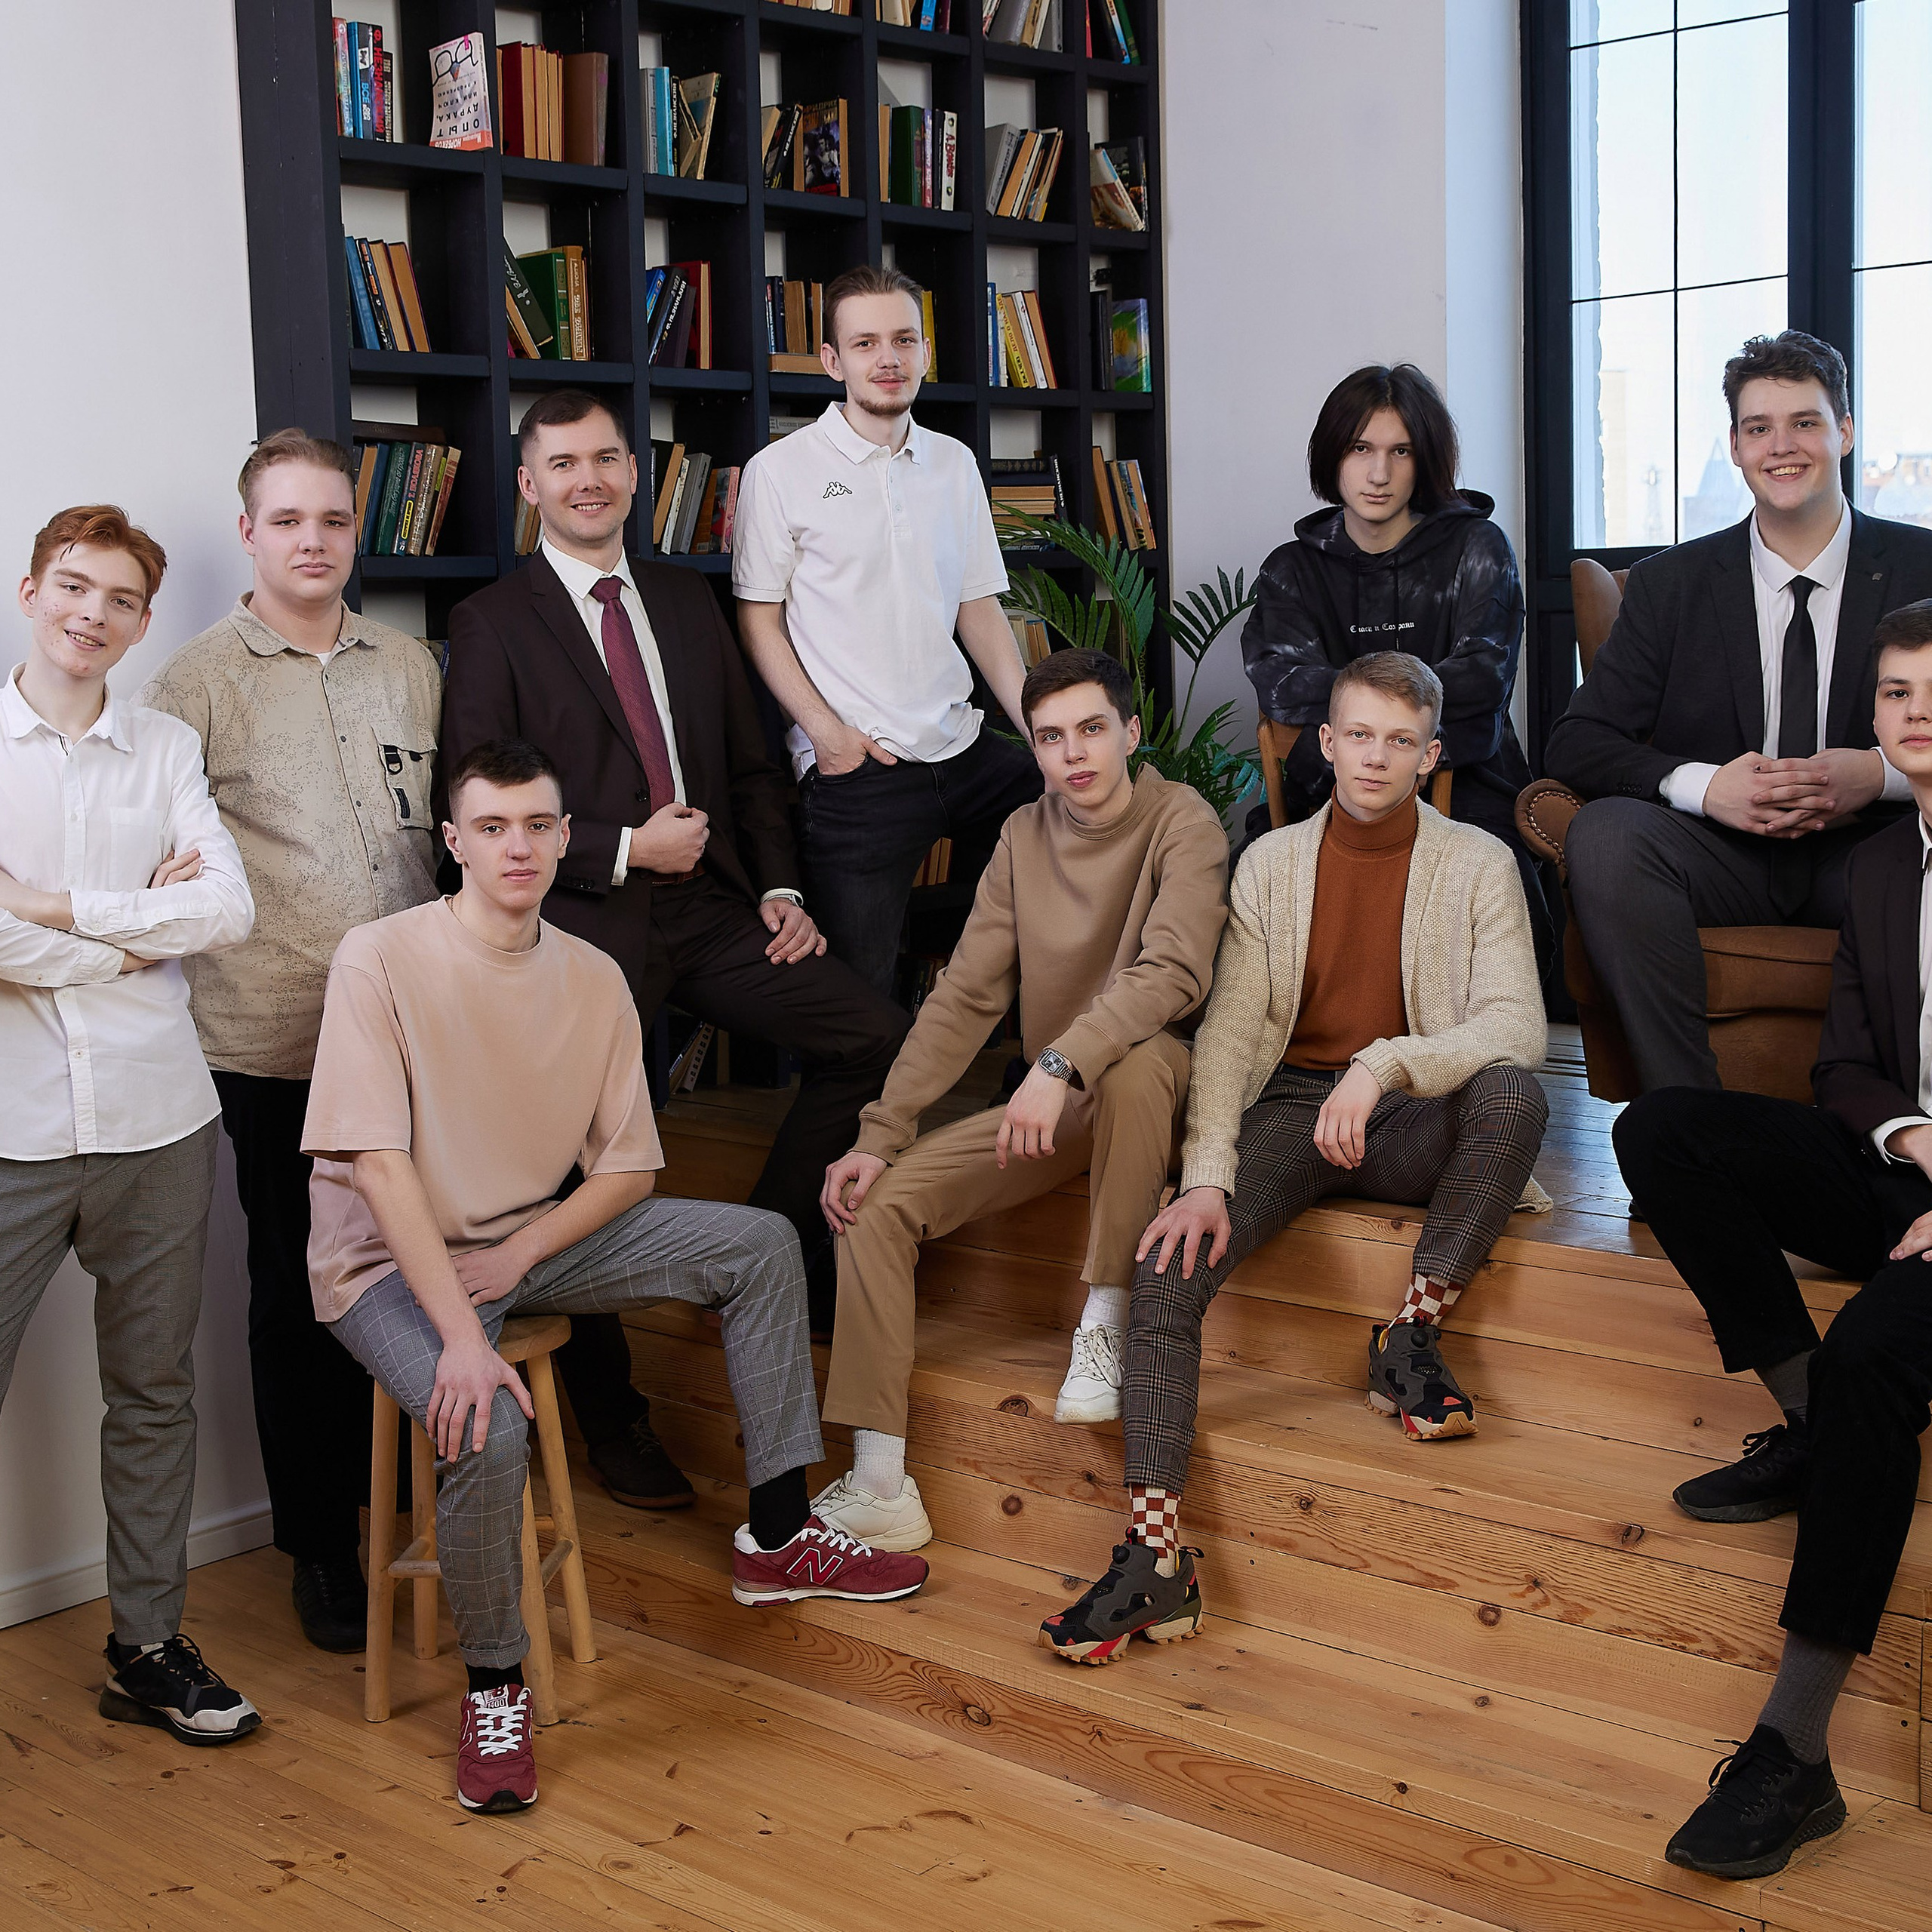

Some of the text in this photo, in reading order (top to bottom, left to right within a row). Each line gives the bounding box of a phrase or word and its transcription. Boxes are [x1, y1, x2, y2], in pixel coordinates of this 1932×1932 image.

[361, 82, 370, 103] ВСЕ
[374, 46, 383, 134] НЕЗНАНСКИЙ
[438, 91, 478, 110] ИЛИ КЛЮЧ
[437, 102, 479, 122] ДУРАКА,
[437, 118, 479, 137] ОПЫТ
[1008, 331, 1018, 352] ДЕЛО
